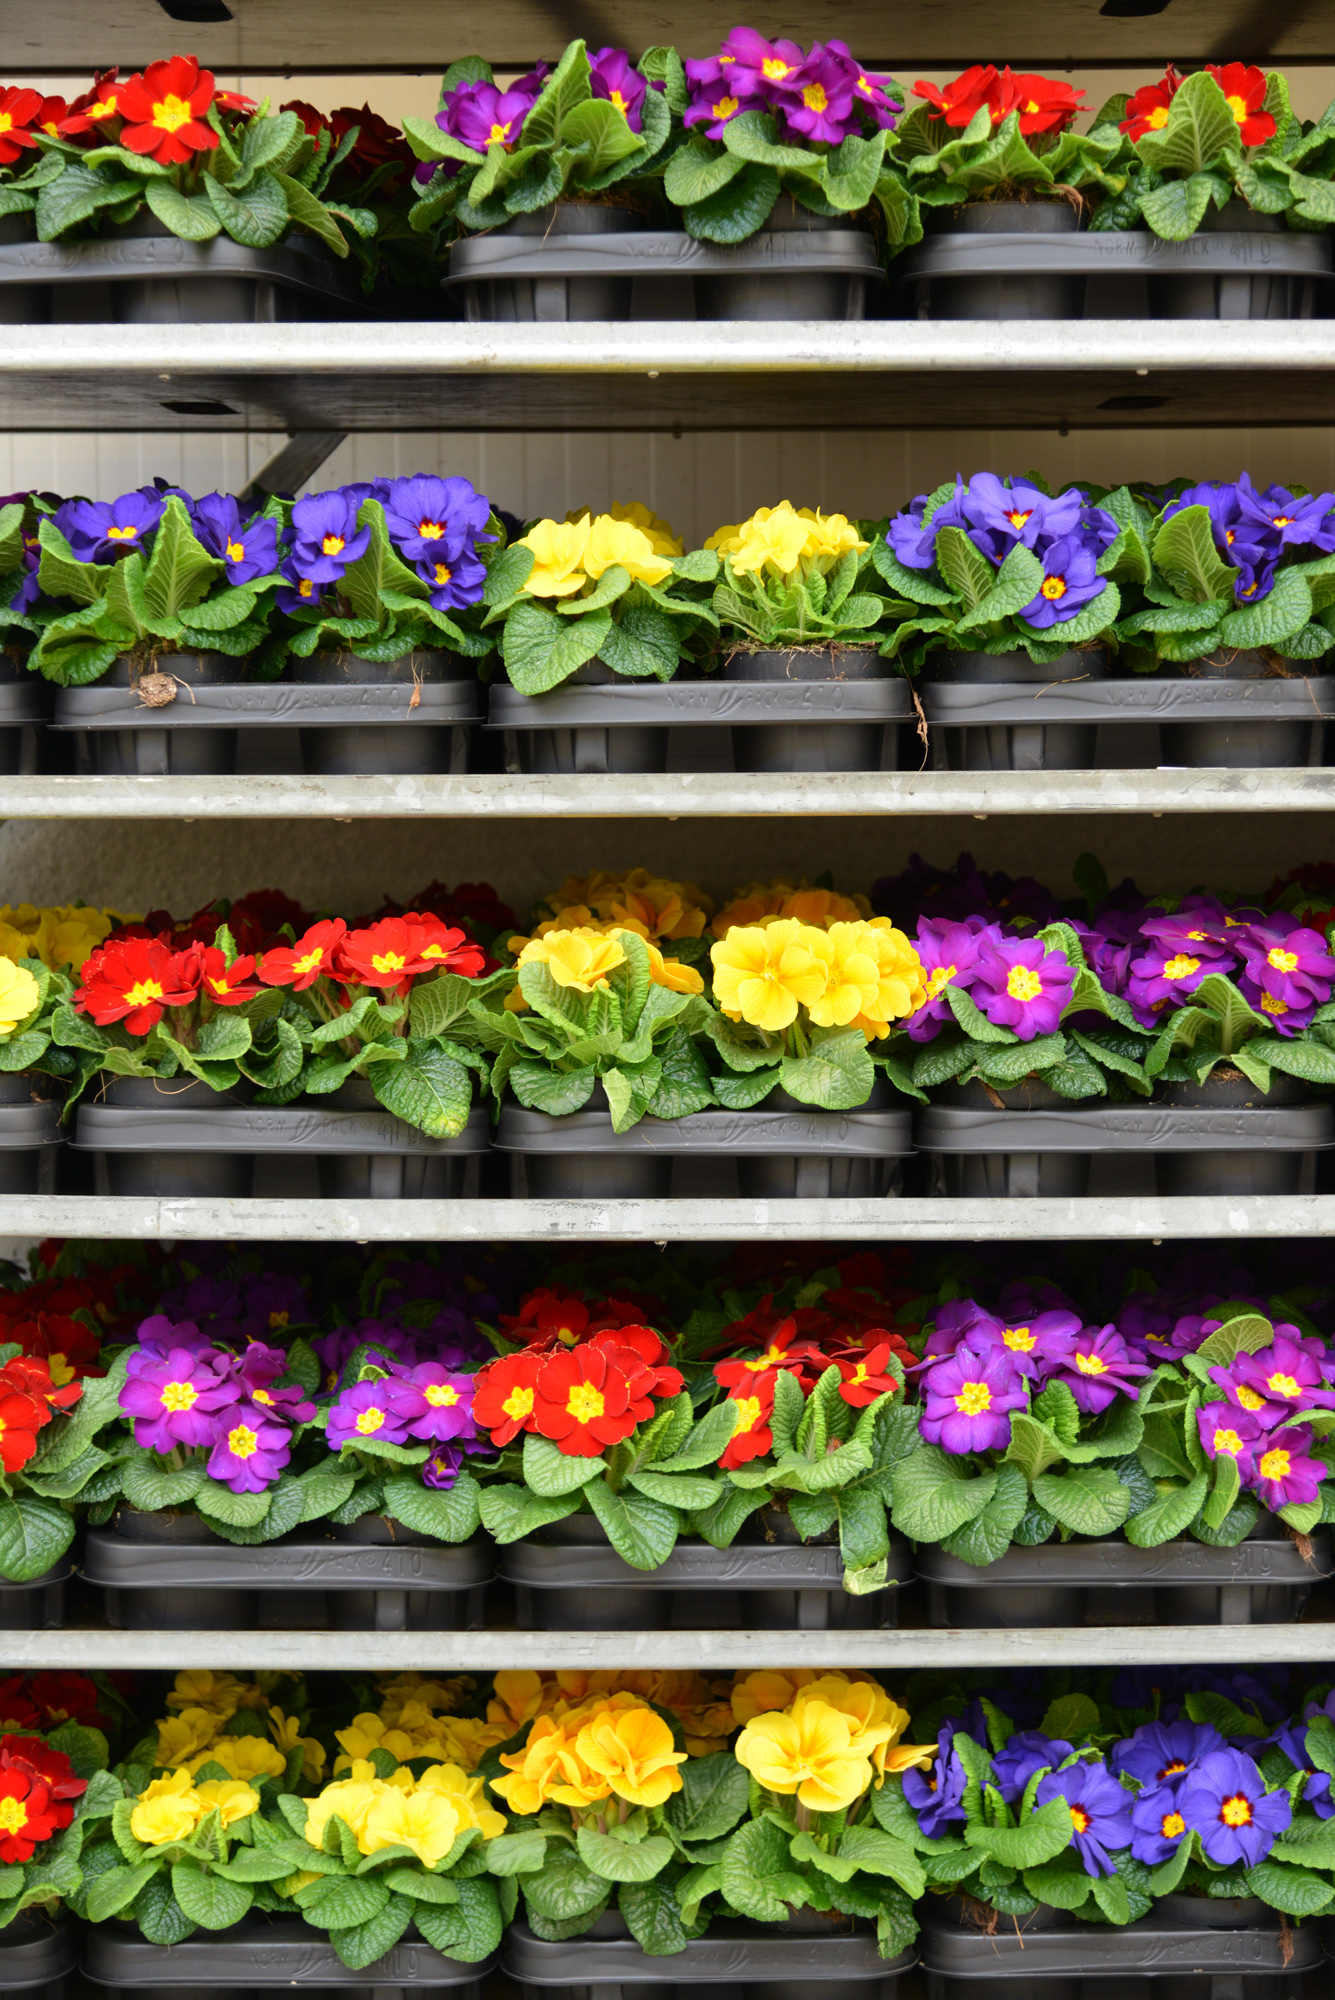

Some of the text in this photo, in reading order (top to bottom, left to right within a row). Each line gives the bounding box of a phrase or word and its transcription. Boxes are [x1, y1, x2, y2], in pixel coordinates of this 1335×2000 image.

[668, 690, 708, 708] NORM
[1107, 689, 1148, 706] NORM
[382, 1551, 422, 1577] 410
[1222, 1937, 1262, 1960] 410
